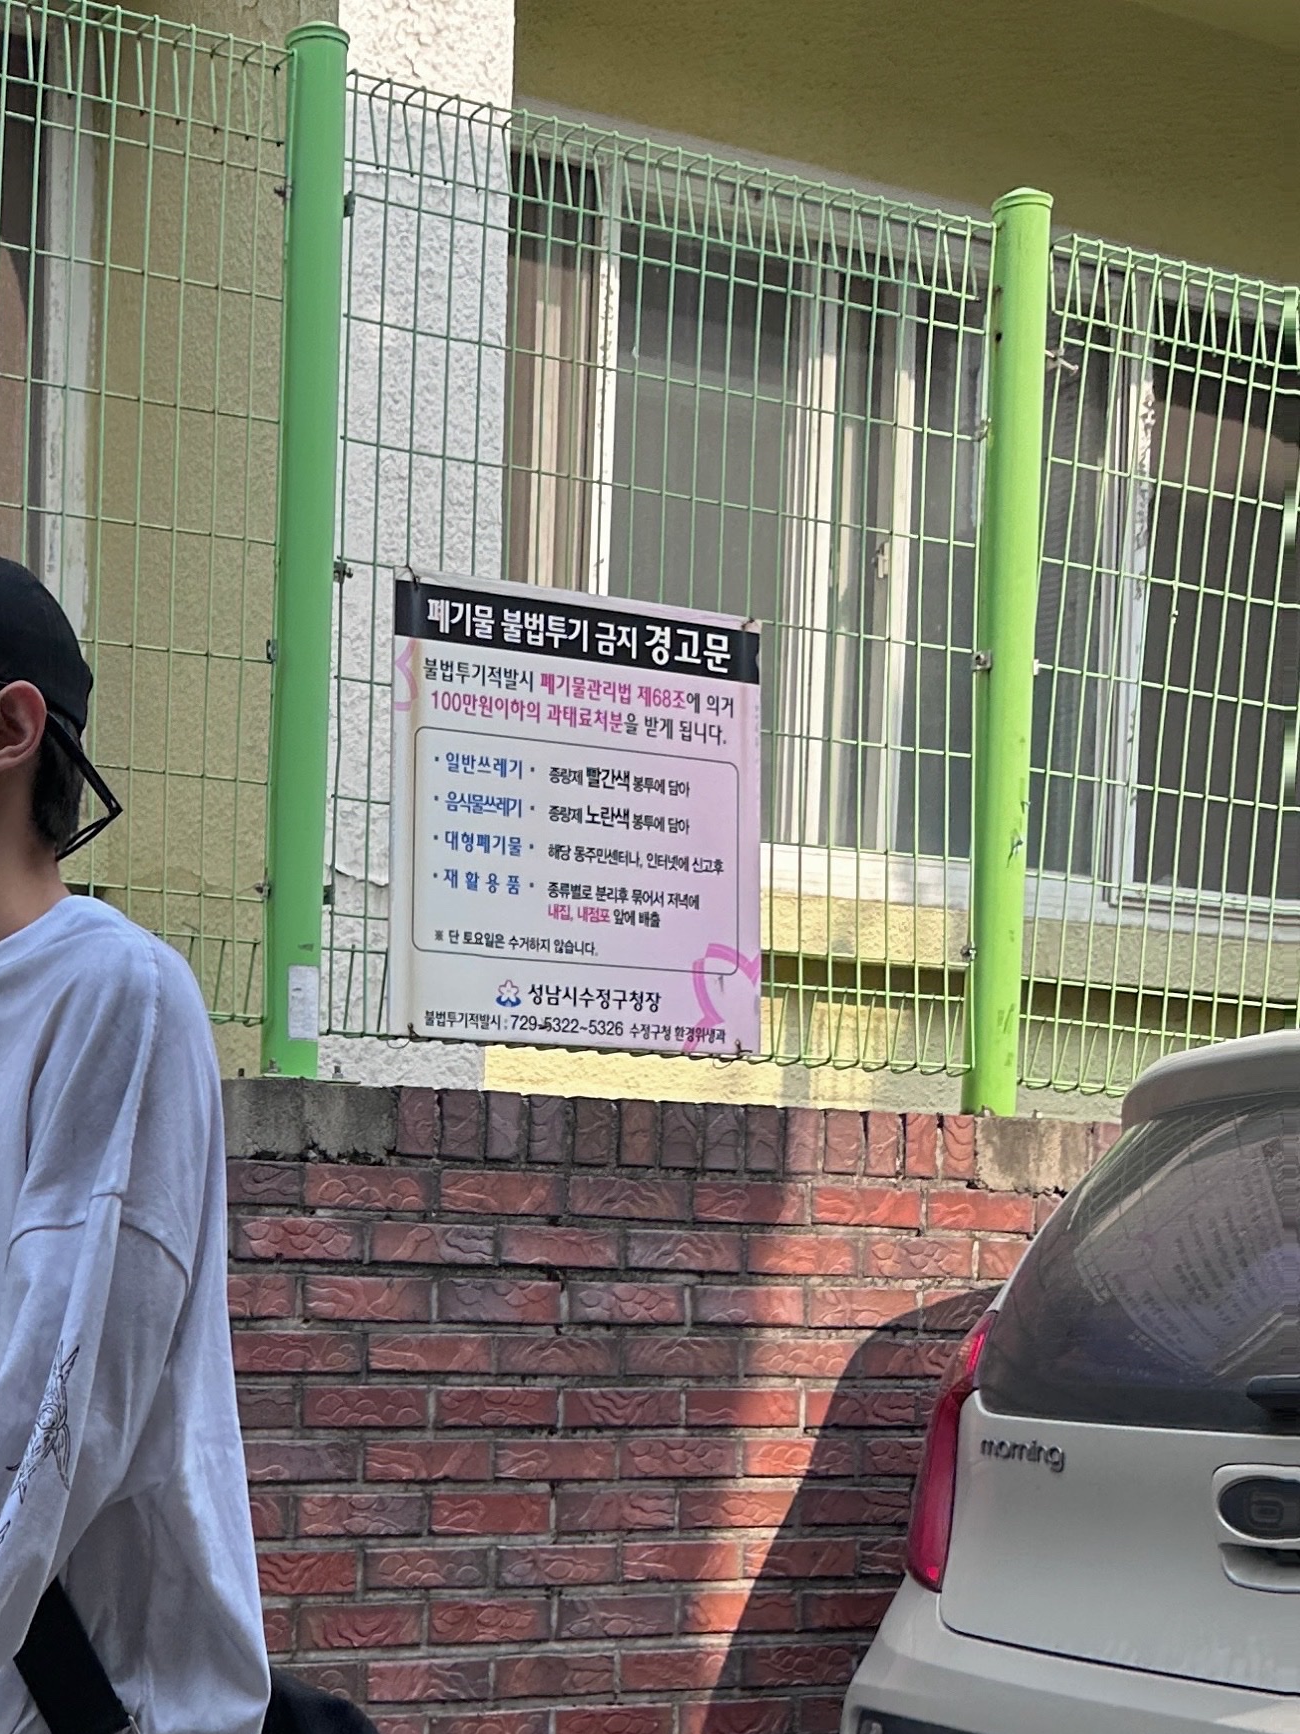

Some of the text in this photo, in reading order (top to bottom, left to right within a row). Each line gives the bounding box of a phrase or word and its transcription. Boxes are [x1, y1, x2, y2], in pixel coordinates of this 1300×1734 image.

[427, 598, 732, 674] 폐기물 불법투기 금지 경고문
[423, 657, 734, 719] 불법투기적발시 폐기물관리법 제68조에 의거
[431, 690, 541, 724] 100만원이하의
[547, 703, 639, 735] 과태료처분을
[644, 716, 674, 740] 받게
[679, 720, 727, 746] 됩니다.
[445, 751, 523, 780] 일반쓰레기
[586, 766, 631, 792] 빨간색
[632, 776, 666, 795] 봉투에
[668, 779, 690, 798] 담아
[444, 791, 523, 819] 음식물쓰레기
[585, 804, 630, 830] 노란색
[632, 813, 665, 833] 봉투에
[667, 817, 690, 835] 담아
[444, 830, 523, 857] 대형폐기물
[548, 843, 571, 861] 해당
[646, 852, 689, 873] 인터넷에
[691, 856, 724, 876] 신고후
[547, 882, 593, 900] 종류별로
[595, 886, 629, 904] 분리후
[631, 889, 665, 908] 묶어서
[667, 892, 700, 911] 저녁에
[613, 909, 636, 926] 앞에
[638, 911, 661, 928] 배출
[449, 929, 460, 945] 단
[463, 931, 505, 949] 토요일은
[508, 935, 550, 953] 수거하지
[527, 983, 662, 1013] 성남시수정구청장
[629, 1023, 672, 1041] 수정구청
[981, 1439, 1065, 1473] morning
